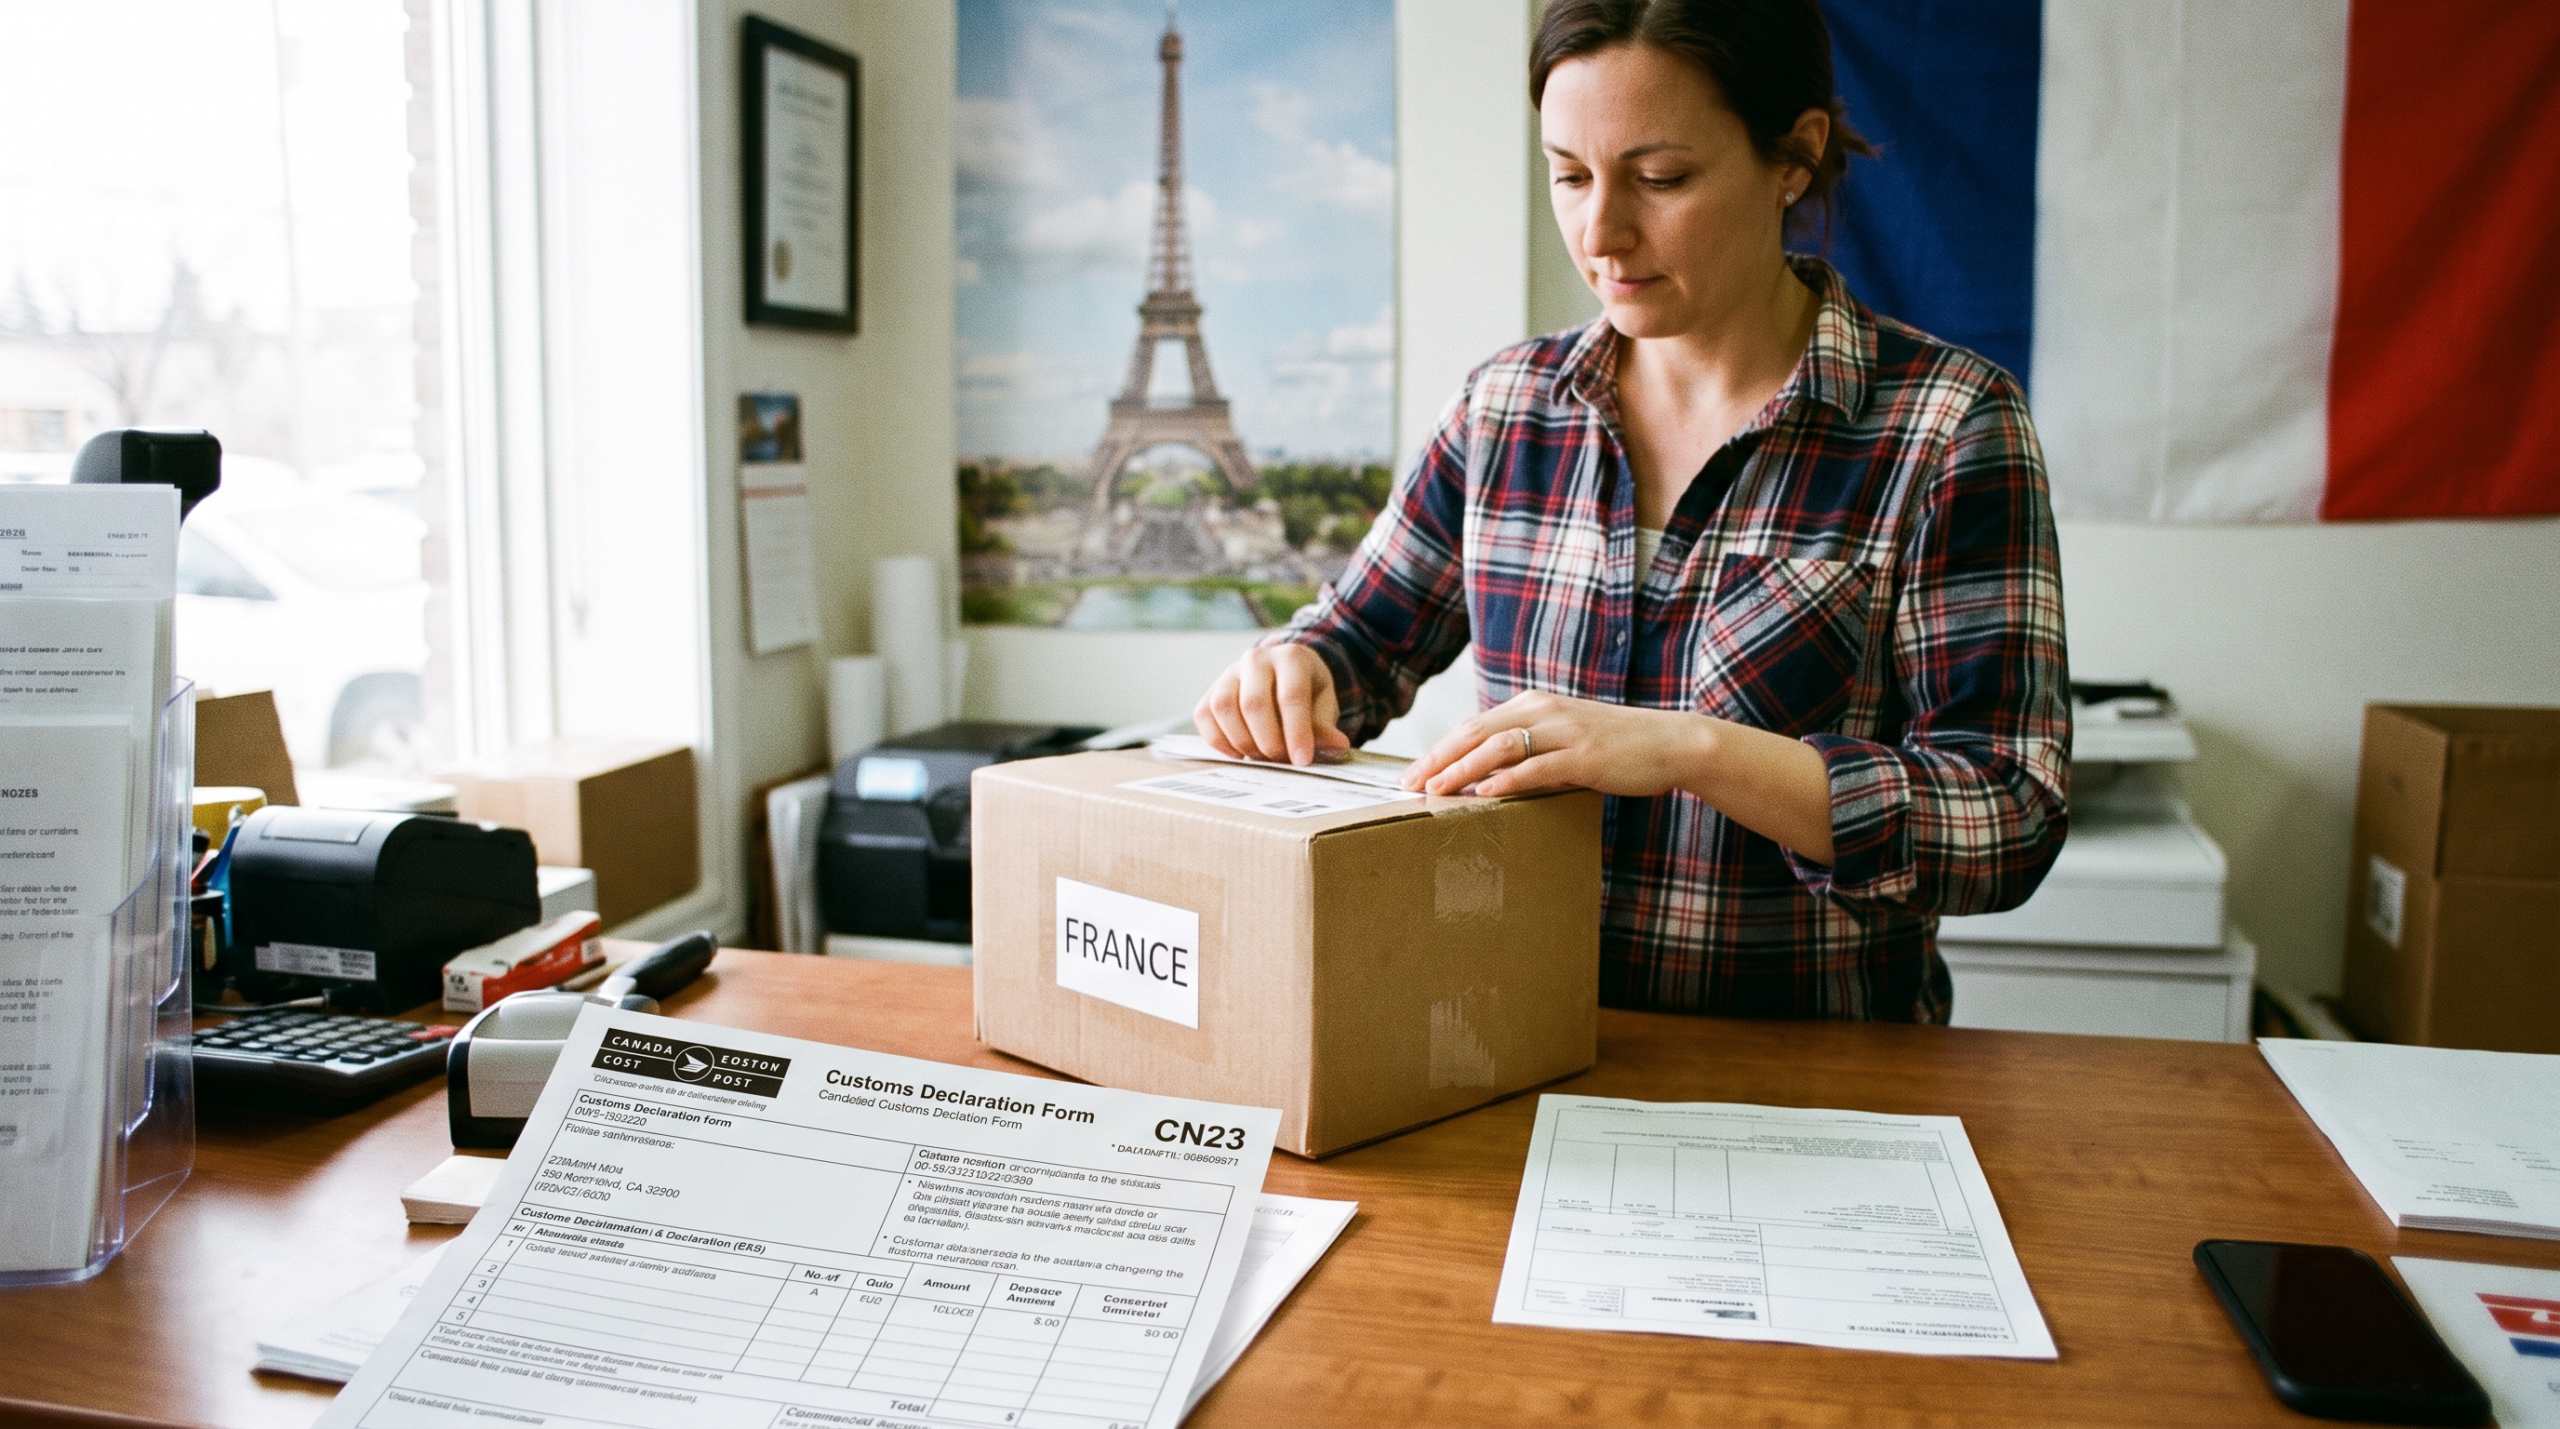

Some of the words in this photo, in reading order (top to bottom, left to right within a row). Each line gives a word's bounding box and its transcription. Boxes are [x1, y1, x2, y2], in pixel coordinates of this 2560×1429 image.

[1065, 917, 1189, 988] FRANCE
[611, 1036, 673, 1055] CANADA
[603, 1055, 642, 1069] COST
[721, 1055, 781, 1072] EOSTON
[712, 1073, 752, 1088] POST
[826, 1069, 914, 1096] Customs
[920, 1084, 1035, 1115] Declaration
[1042, 1102, 1095, 1124] Form
[579, 1094, 631, 1111] Customs
[633, 1103, 701, 1123] Declaration
[703, 1115, 732, 1128] form
[878, 1099, 930, 1116] Customs
[932, 1107, 988, 1125] Declation
[991, 1115, 1023, 1130] Form
[1154, 1119, 1246, 1150] CN23
[1088, 1173, 1099, 1183] to
[1101, 1175, 1117, 1185] the
[626, 1181, 643, 1193] CA
[520, 1207, 571, 1224] Custome
[1146, 1211, 1159, 1219] or
[506, 1239, 514, 1248] 1
[487, 1263, 498, 1274] 2
[1033, 1254, 1050, 1264] the
[1166, 1269, 1184, 1279] the
[477, 1279, 488, 1289] 3
[922, 1278, 971, 1292] Amount
[809, 1287, 820, 1297] A
[467, 1295, 476, 1305] 4
[455, 1311, 466, 1321] 5
[889, 1399, 927, 1414] Total
